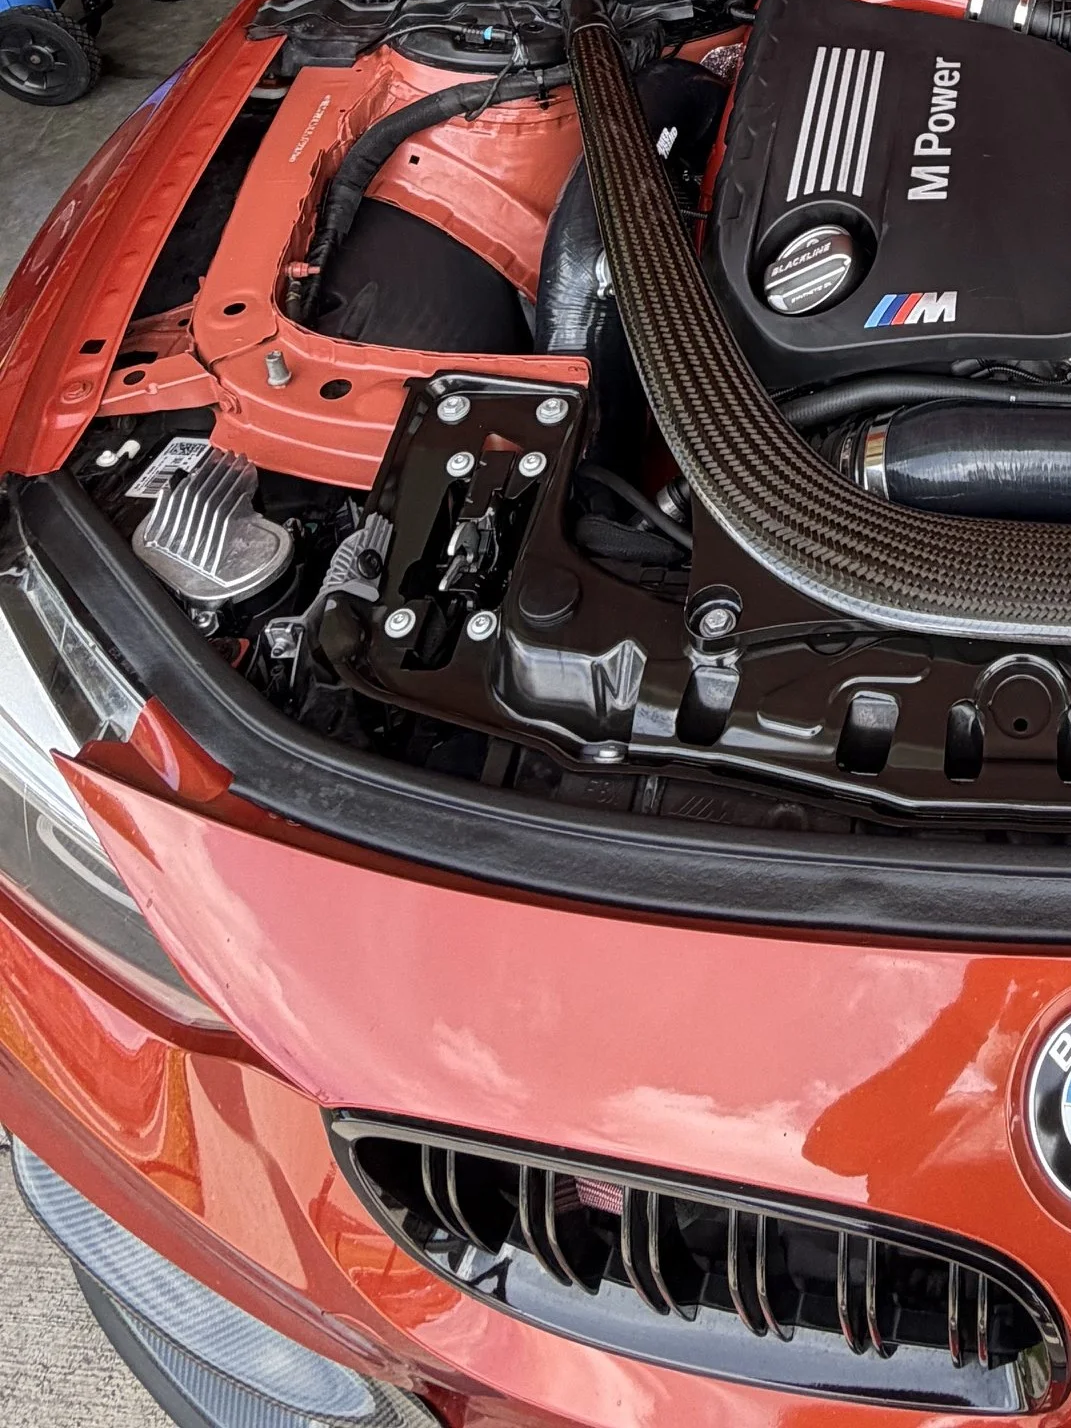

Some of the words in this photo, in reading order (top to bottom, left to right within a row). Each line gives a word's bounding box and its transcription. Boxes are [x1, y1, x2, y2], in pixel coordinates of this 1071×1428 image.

[914, 56, 961, 156] Power
[907, 165, 950, 200] M
[770, 241, 831, 278] BLACKLINE
[904, 291, 957, 324] M
